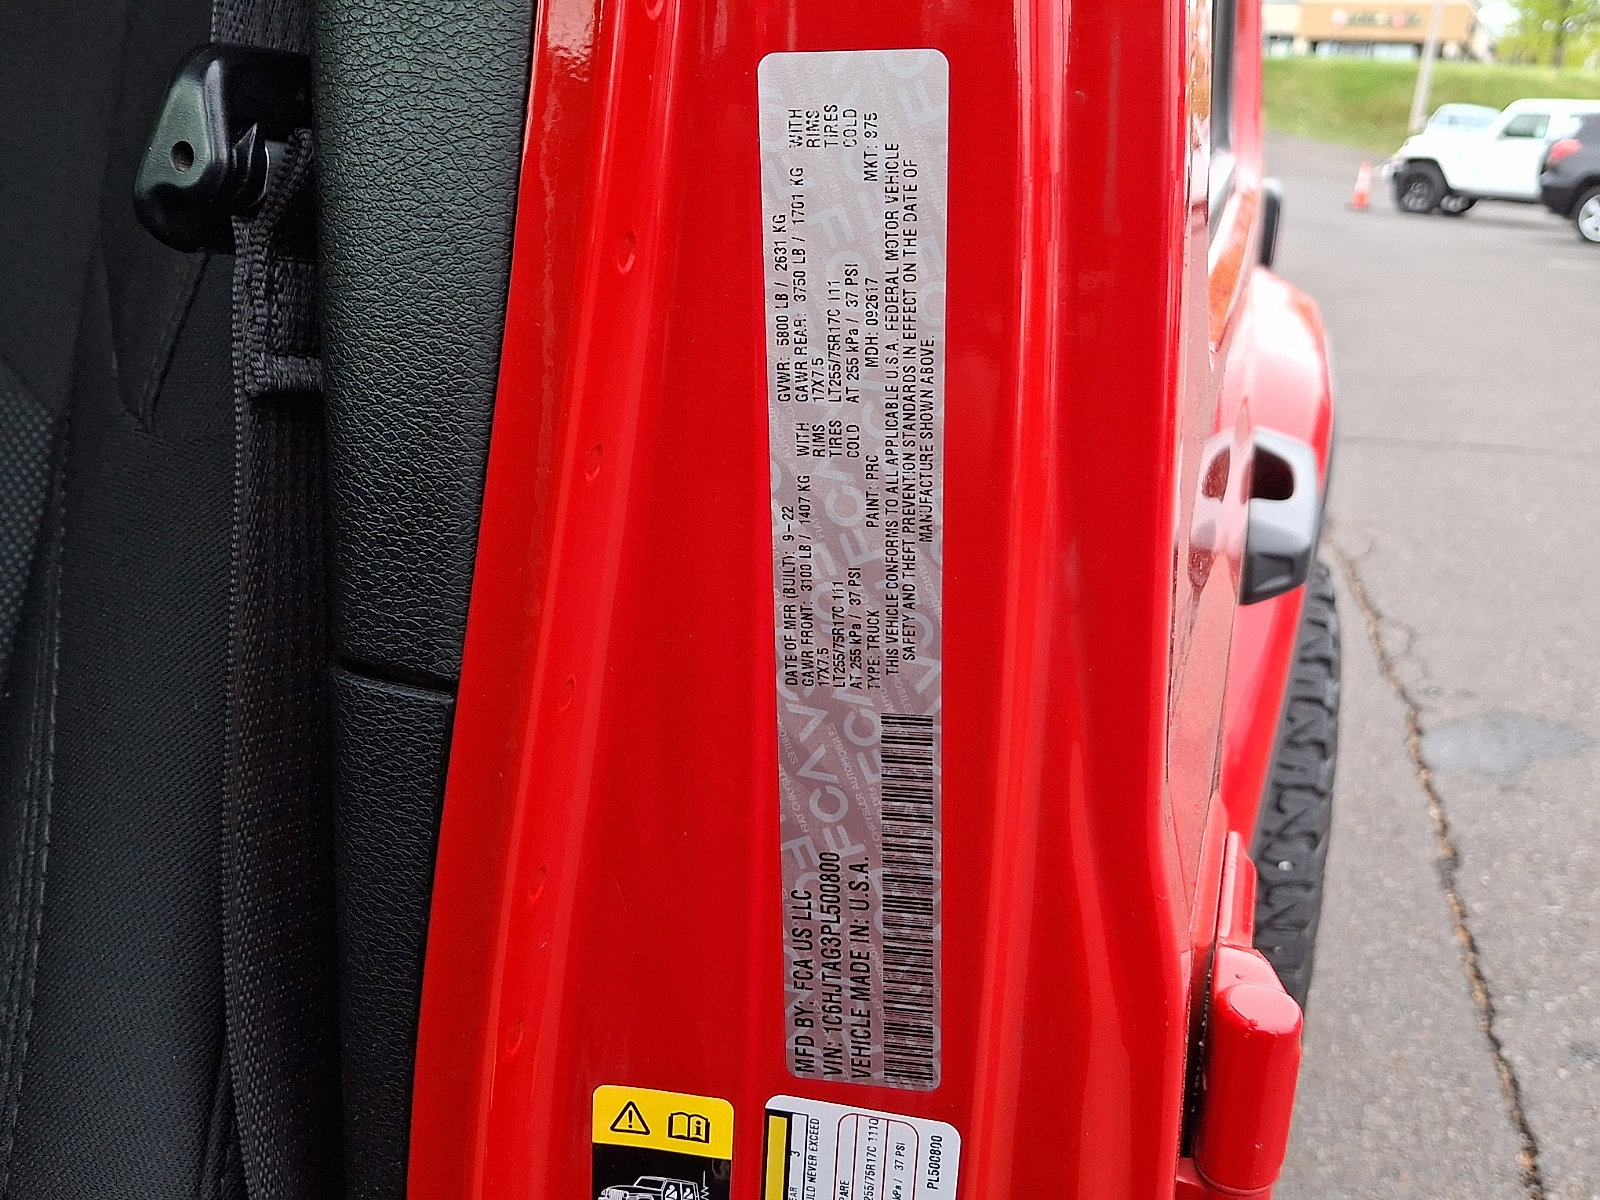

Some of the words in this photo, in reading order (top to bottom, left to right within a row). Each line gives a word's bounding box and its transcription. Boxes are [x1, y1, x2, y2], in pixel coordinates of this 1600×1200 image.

[788, 109, 802, 148] WITH
[806, 110, 819, 148] RIMS
[824, 104, 838, 148] TIRES
[843, 109, 857, 147] COLD
[790, 167, 803, 186] KG
[864, 145, 877, 181] MKT:
[885, 143, 899, 203] VEHICLE
[904, 159, 917, 177] OF
[792, 194, 804, 225] 1701
[904, 184, 917, 221] DATE
[773, 214, 786, 233] KG
[885, 210, 899, 260] MOTOR
[774, 240, 787, 271] 2631
[792, 249, 805, 264] LB
[904, 228, 917, 257] THE
[793, 271, 806, 302] 3750
[845, 264, 858, 285] PSI
[903, 263, 916, 282] ON
[775, 294, 788, 309] LB
[828, 280, 840, 301] 111
[846, 292, 858, 307] 37
[865, 277, 878, 326] 092617
[885, 267, 899, 331] FEDERAL
[776, 316, 789, 346] 5800
[903, 289, 916, 340] EFFECT
[795, 314, 808, 355] REAR:
[846, 329, 859, 352] kPa
[865, 332, 878, 367] MDH:
[828, 309, 841, 403] LT255/75R17C
[846, 358, 859, 380] 255
[885, 338, 899, 379] U.S.A.
[902, 347, 916, 359] IN
[920, 335, 934, 384] ABOVE.
[777, 356, 791, 402] GVWR:
[795, 361, 808, 402] GAWR
[812, 358, 824, 402] 17X7.5
[846, 386, 859, 403] AT
[902, 365, 916, 447] STANDARDS
[920, 390, 933, 439] SHOWN
[796, 423, 809, 456] WITH
[813, 425, 825, 457] RIMS
[829, 421, 842, 457] TIRES
[847, 425, 859, 458] COLD
[885, 385, 899, 465] APPLICABLE
[798, 475, 810, 491] KG
[866, 455, 879, 480] PRC
[885, 471, 898, 494] ALL
[866, 486, 879, 528] PAINT:
[886, 498, 898, 514] TO
[902, 452, 916, 533] PREVENTION
[920, 445, 933, 542] MANUFACTURE
[799, 497, 811, 524] 1407
[799, 545, 812, 559] LB
[886, 520, 899, 589] CONFORMS
[902, 538, 915, 578] THEFT
[782, 551, 799, 598] (BUILT):
[799, 565, 813, 592] 3100
[832, 582, 844, 600] 111
[848, 568, 861, 586] PSI
[849, 592, 861, 605] 37
[902, 584, 915, 610] AND
[783, 604, 797, 630] MFR
[800, 601, 813, 645] FRONT:
[849, 623, 861, 644] kPa
[867, 611, 880, 650] TRUCK
[886, 594, 898, 643] VEHICLE
[784, 634, 797, 650] OF
[832, 605, 845, 687] LT255/75R17C
[902, 614, 915, 660] SAFETY
[784, 654, 798, 685] DATE
[801, 651, 814, 686] GAWR
[817, 648, 829, 686] 17X7.5
[850, 649, 862, 669] 255
[867, 655, 880, 689] TYPE:
[886, 649, 898, 675] THIS
[849, 674, 862, 689] AT
[849, 856, 869, 911] U.S.A.
[791, 890, 811, 919] LLC
[792, 929, 812, 951] US
[819, 852, 842, 1033] 1C6HJTAG3PL500800
[850, 920, 869, 943] IN:
[793, 959, 813, 990] FCA
[850, 951, 870, 1001] MADE
[794, 1001, 813, 1028] BY:
[795, 1036, 815, 1073] MFD
[824, 1042, 842, 1075] VIN:
[850, 1009, 871, 1078] VEHICLE
[809, 1118, 819, 1152] EXCEED
[895, 1142, 905, 1157] PSI
[807, 1155, 817, 1183] NEVER
[894, 1160, 903, 1170] 37
[927, 1135, 942, 1190] PL500800
